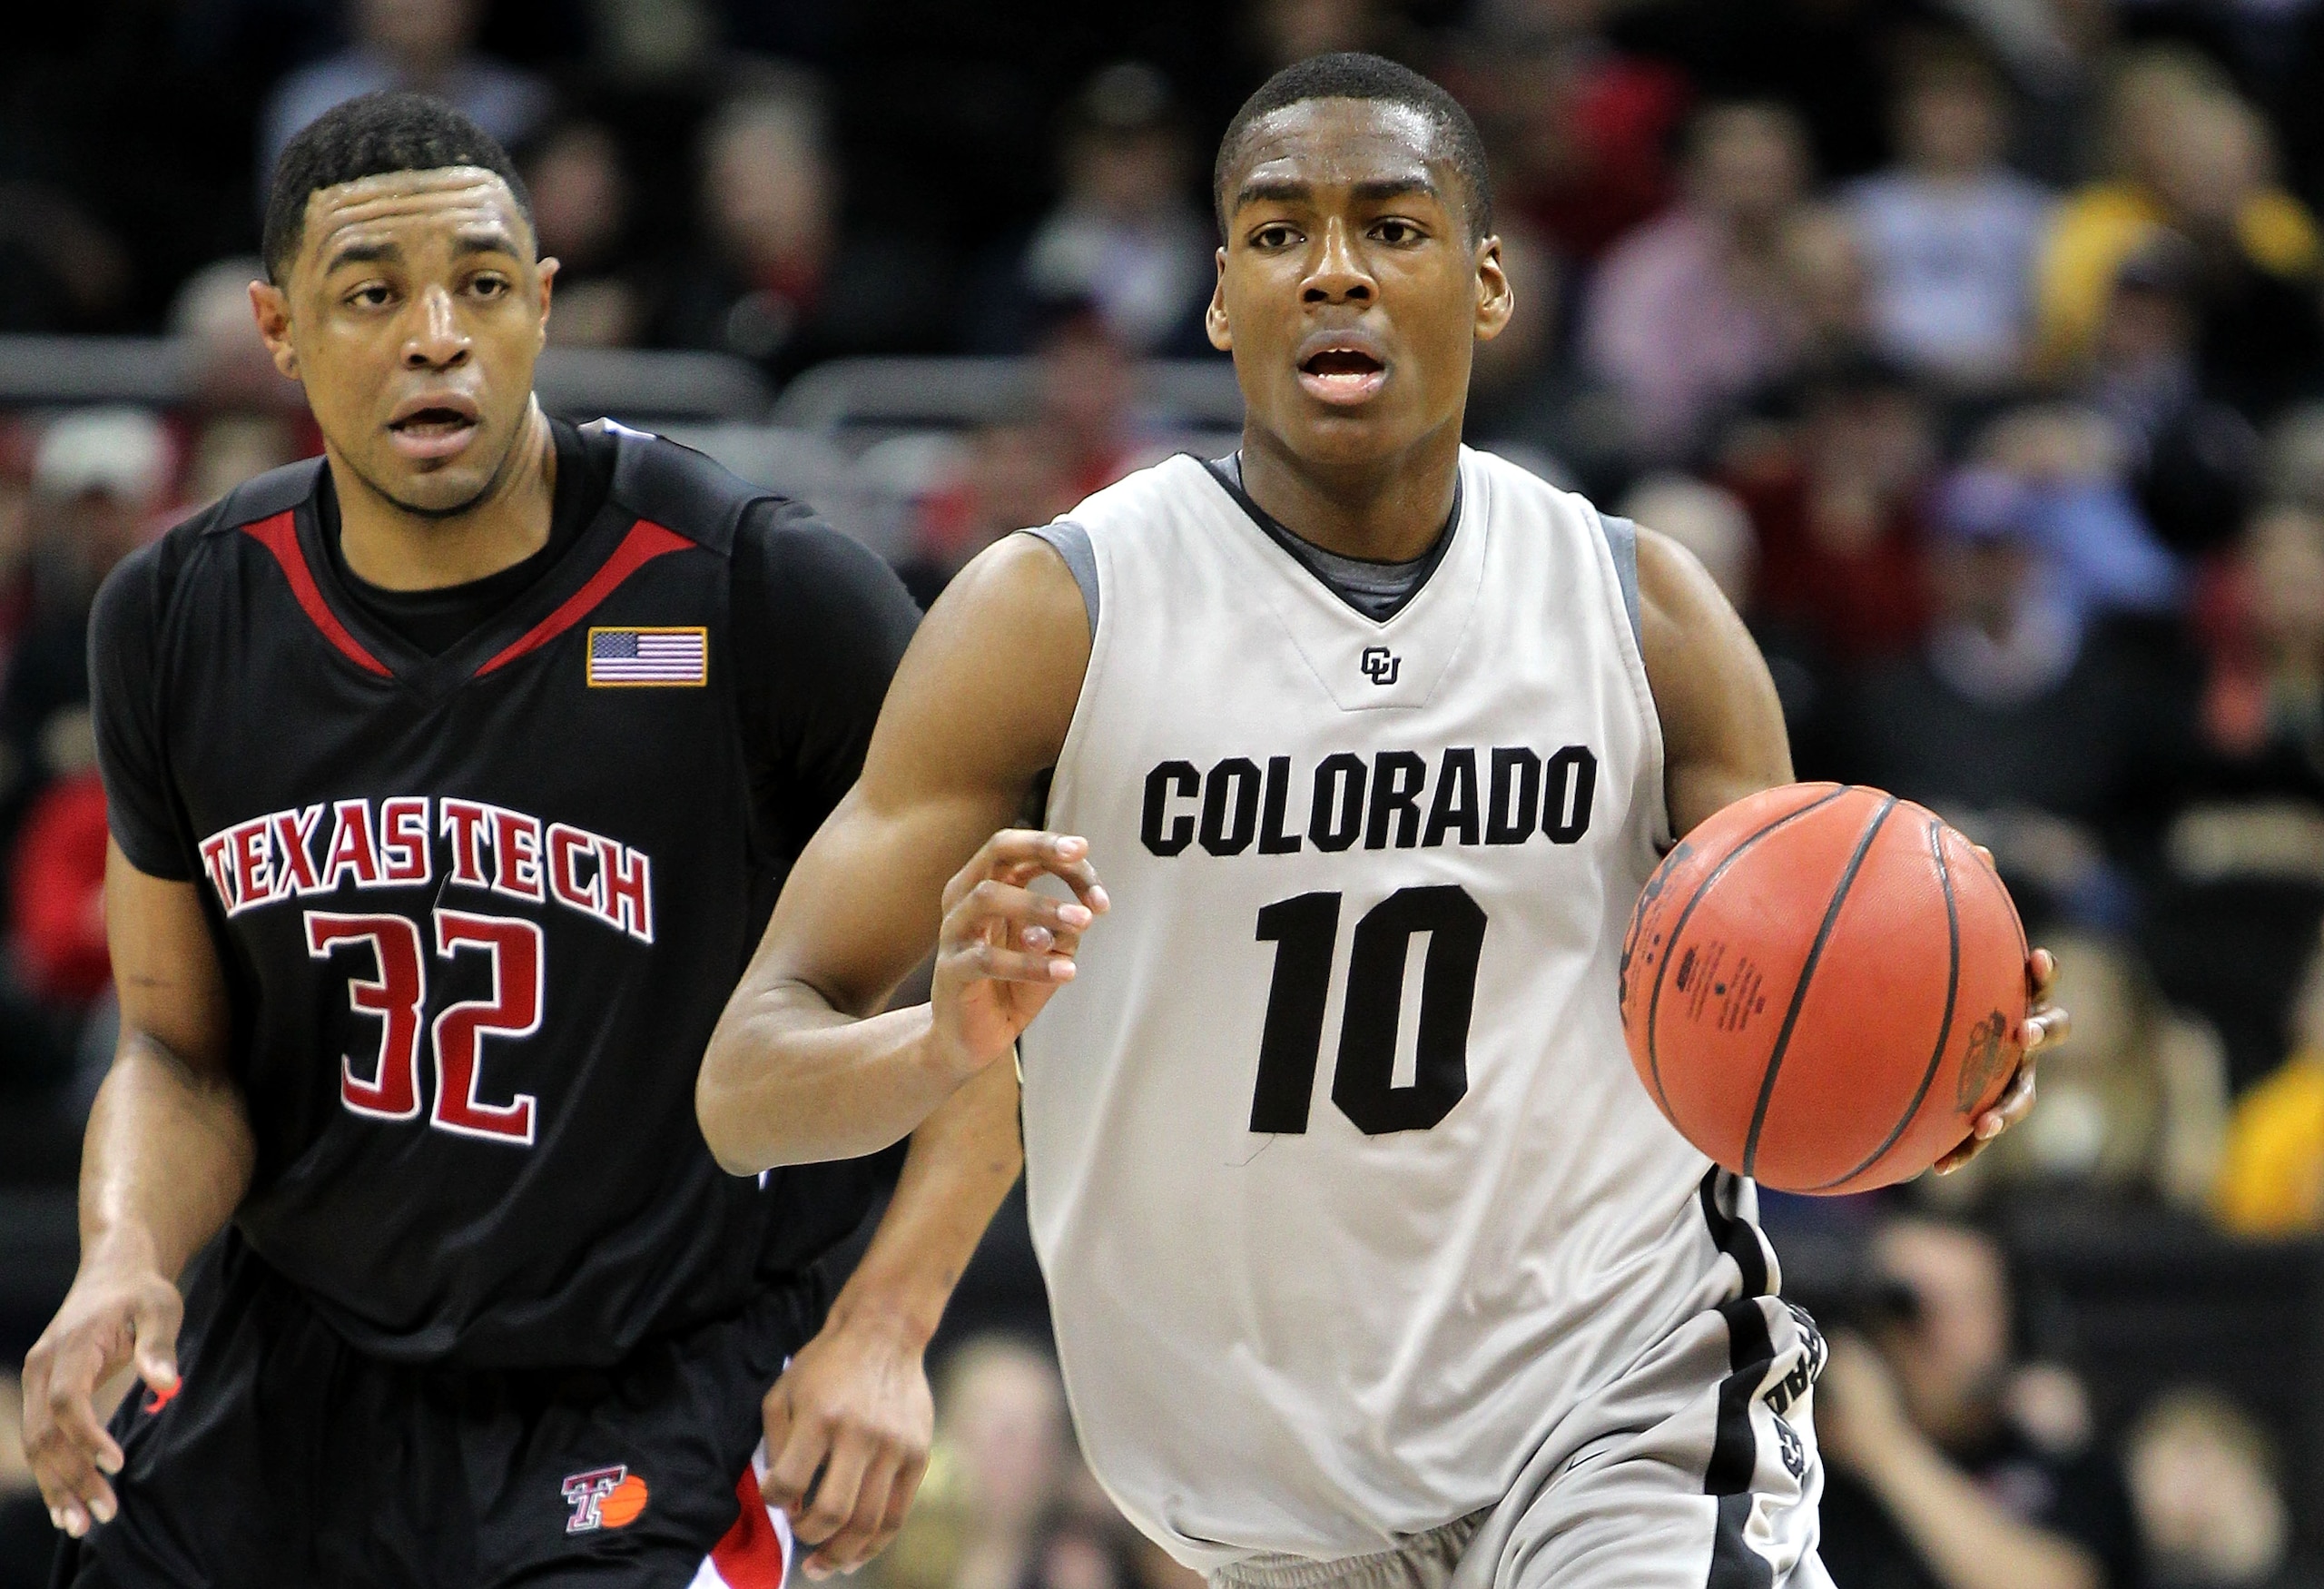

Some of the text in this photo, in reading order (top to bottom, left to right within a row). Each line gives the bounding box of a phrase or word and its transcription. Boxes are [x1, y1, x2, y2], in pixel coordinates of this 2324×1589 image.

[1361, 646, 1401, 685] CU
[198, 795, 655, 943] TEXAS TECH
[1140, 745, 1598, 856] COLORADO
[303, 909, 544, 1146] 32
[1249, 884, 1488, 1135] 10
